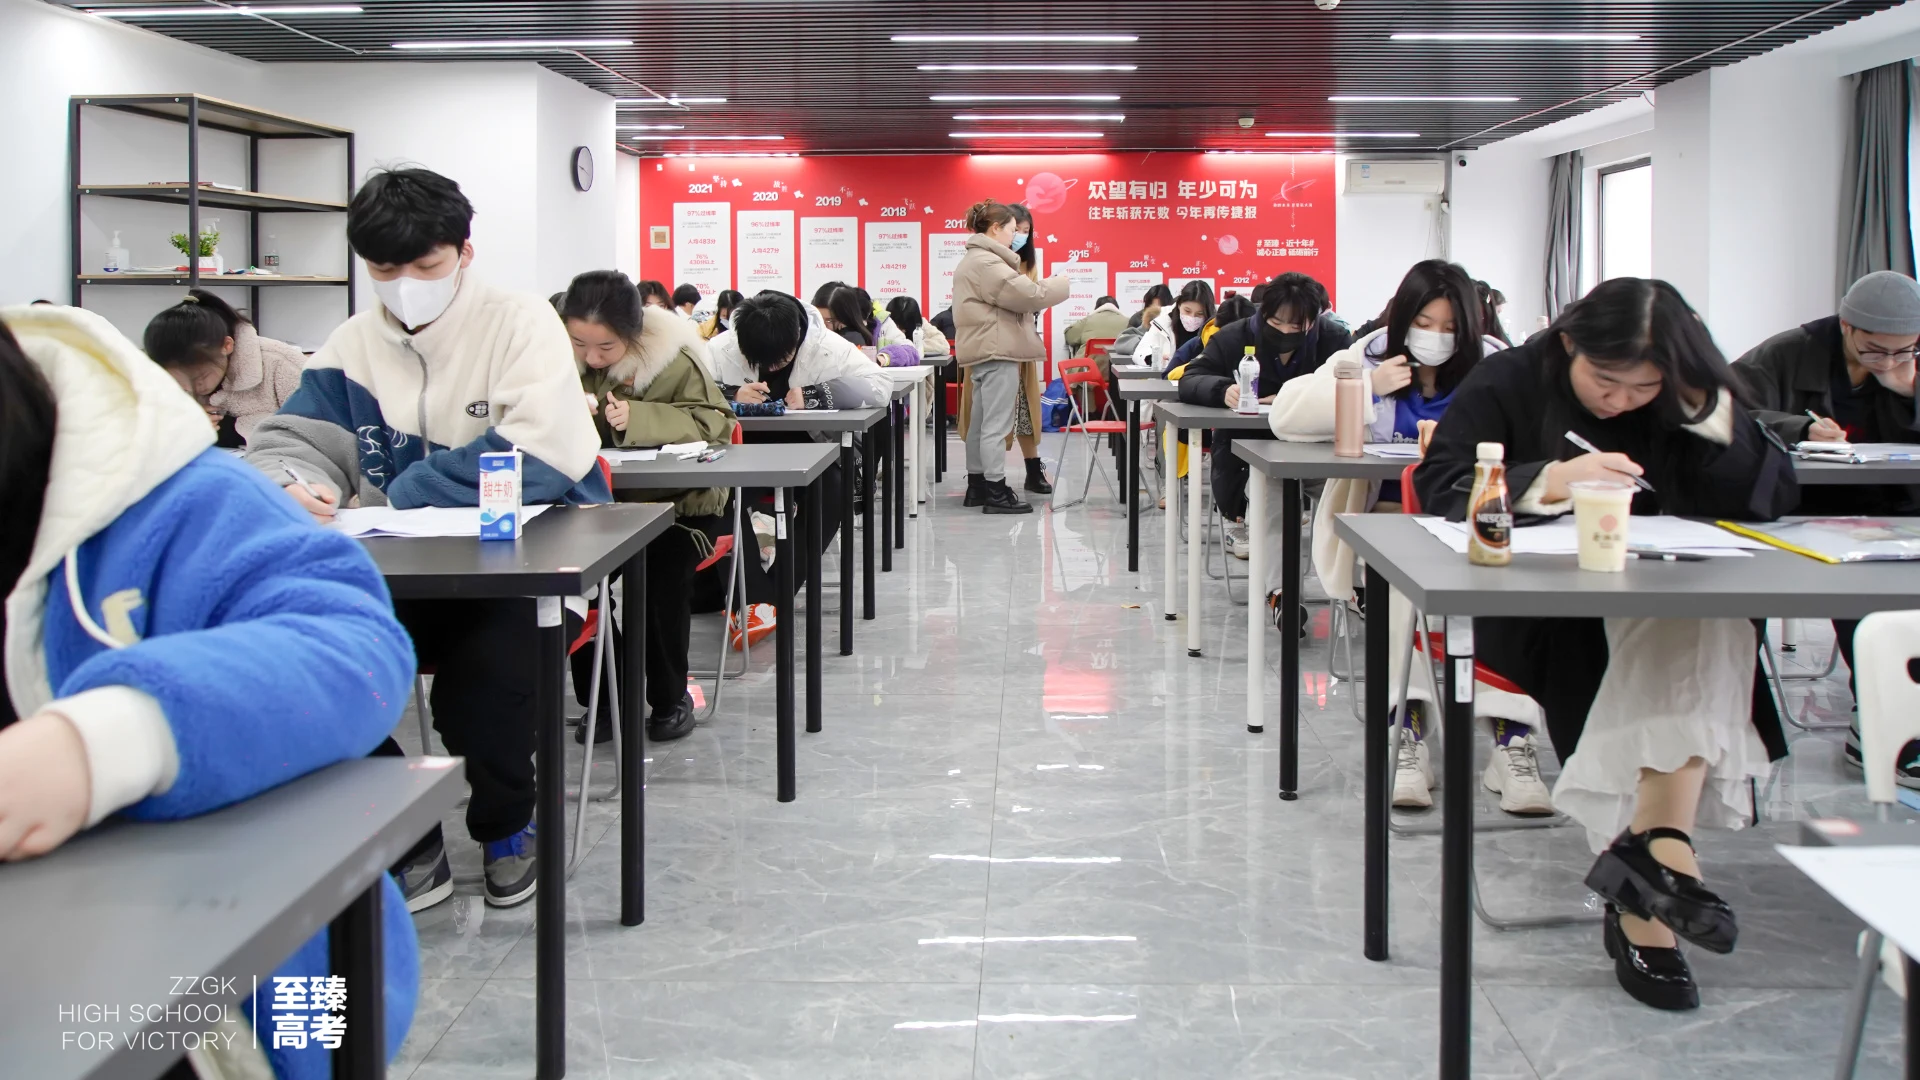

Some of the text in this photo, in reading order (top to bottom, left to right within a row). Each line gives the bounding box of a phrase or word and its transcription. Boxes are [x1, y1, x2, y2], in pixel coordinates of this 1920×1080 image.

[688, 184, 713, 193] 2021
[1088, 180, 1257, 200] 众望有归 年少可为
[752, 191, 779, 201] 2020
[815, 196, 842, 206] 2019
[880, 207, 907, 217] 2018
[1088, 206, 1257, 220] 往年斩获无数 今年再传捷报
[944, 219, 968, 229] 2017
[1068, 250, 1090, 258] 2015
[1182, 267, 1201, 275] 2013
[484, 481, 512, 498] 甜牛奶
